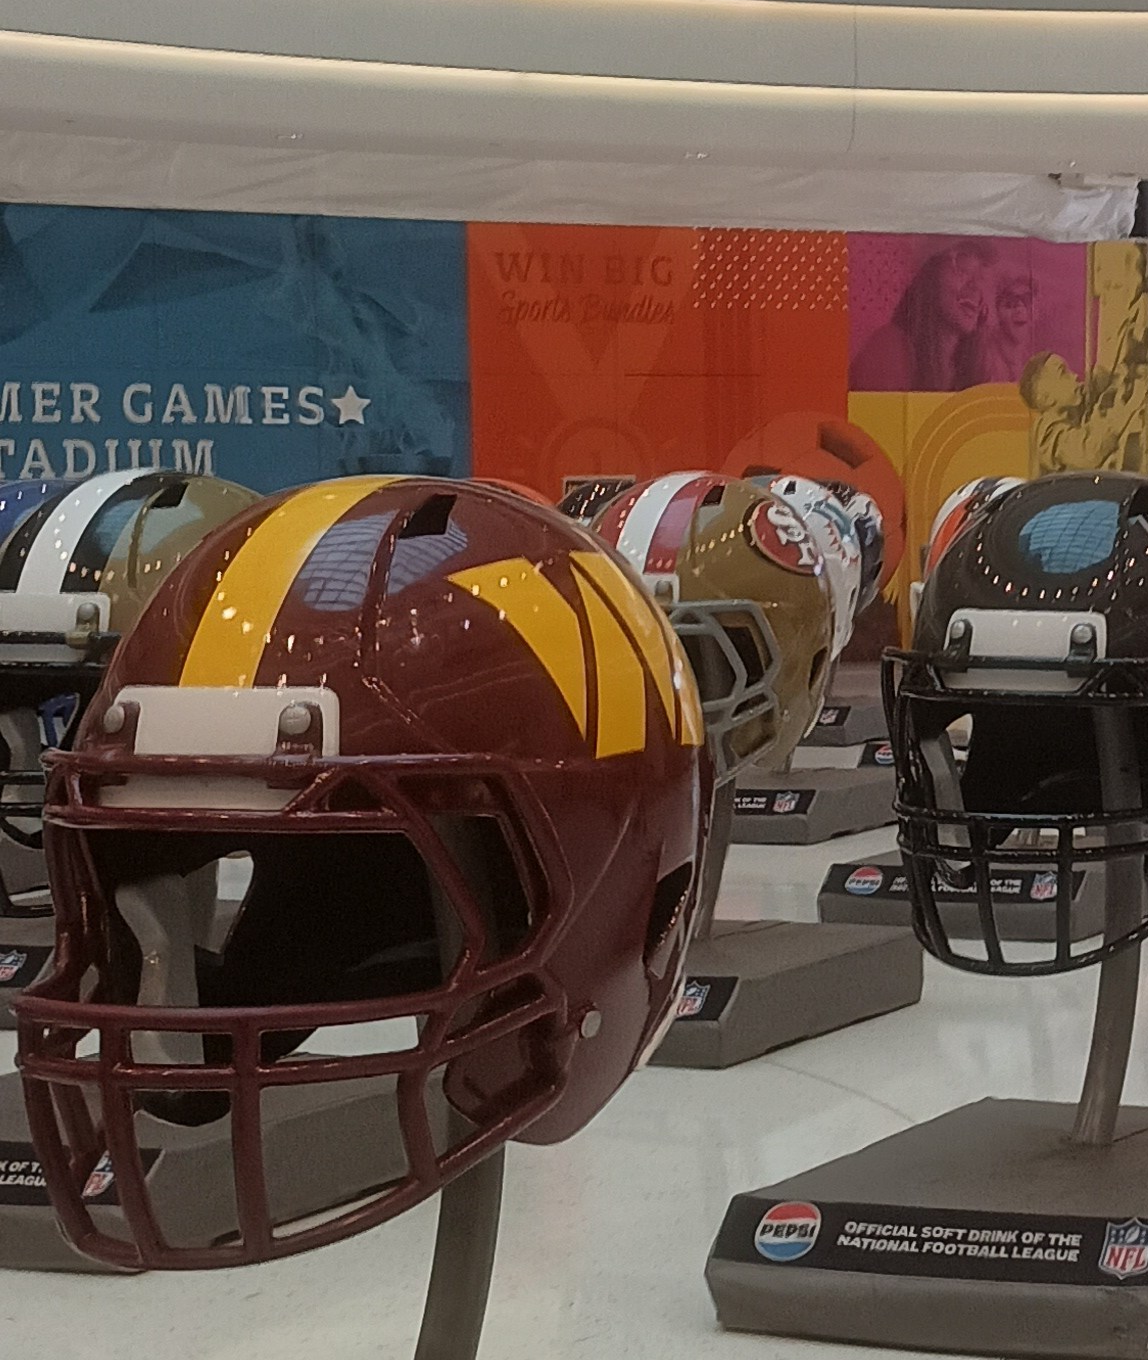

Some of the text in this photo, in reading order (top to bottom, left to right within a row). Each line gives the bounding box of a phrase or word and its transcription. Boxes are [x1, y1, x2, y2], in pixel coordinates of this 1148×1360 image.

[495, 252, 673, 286] WIN BIG
[501, 291, 571, 328] Sports
[122, 383, 324, 426] GAMES
[9, 1161, 30, 1172] OF
[0, 1174, 47, 1187] LEAGU
[760, 1223, 816, 1238] PEPSI
[844, 1221, 1083, 1247] OFFICIAL SOFT DRINK OF THE
[836, 1235, 1080, 1262] NATIONAL FOOTBALL LEAGUE
[1105, 1246, 1147, 1272] NFL
